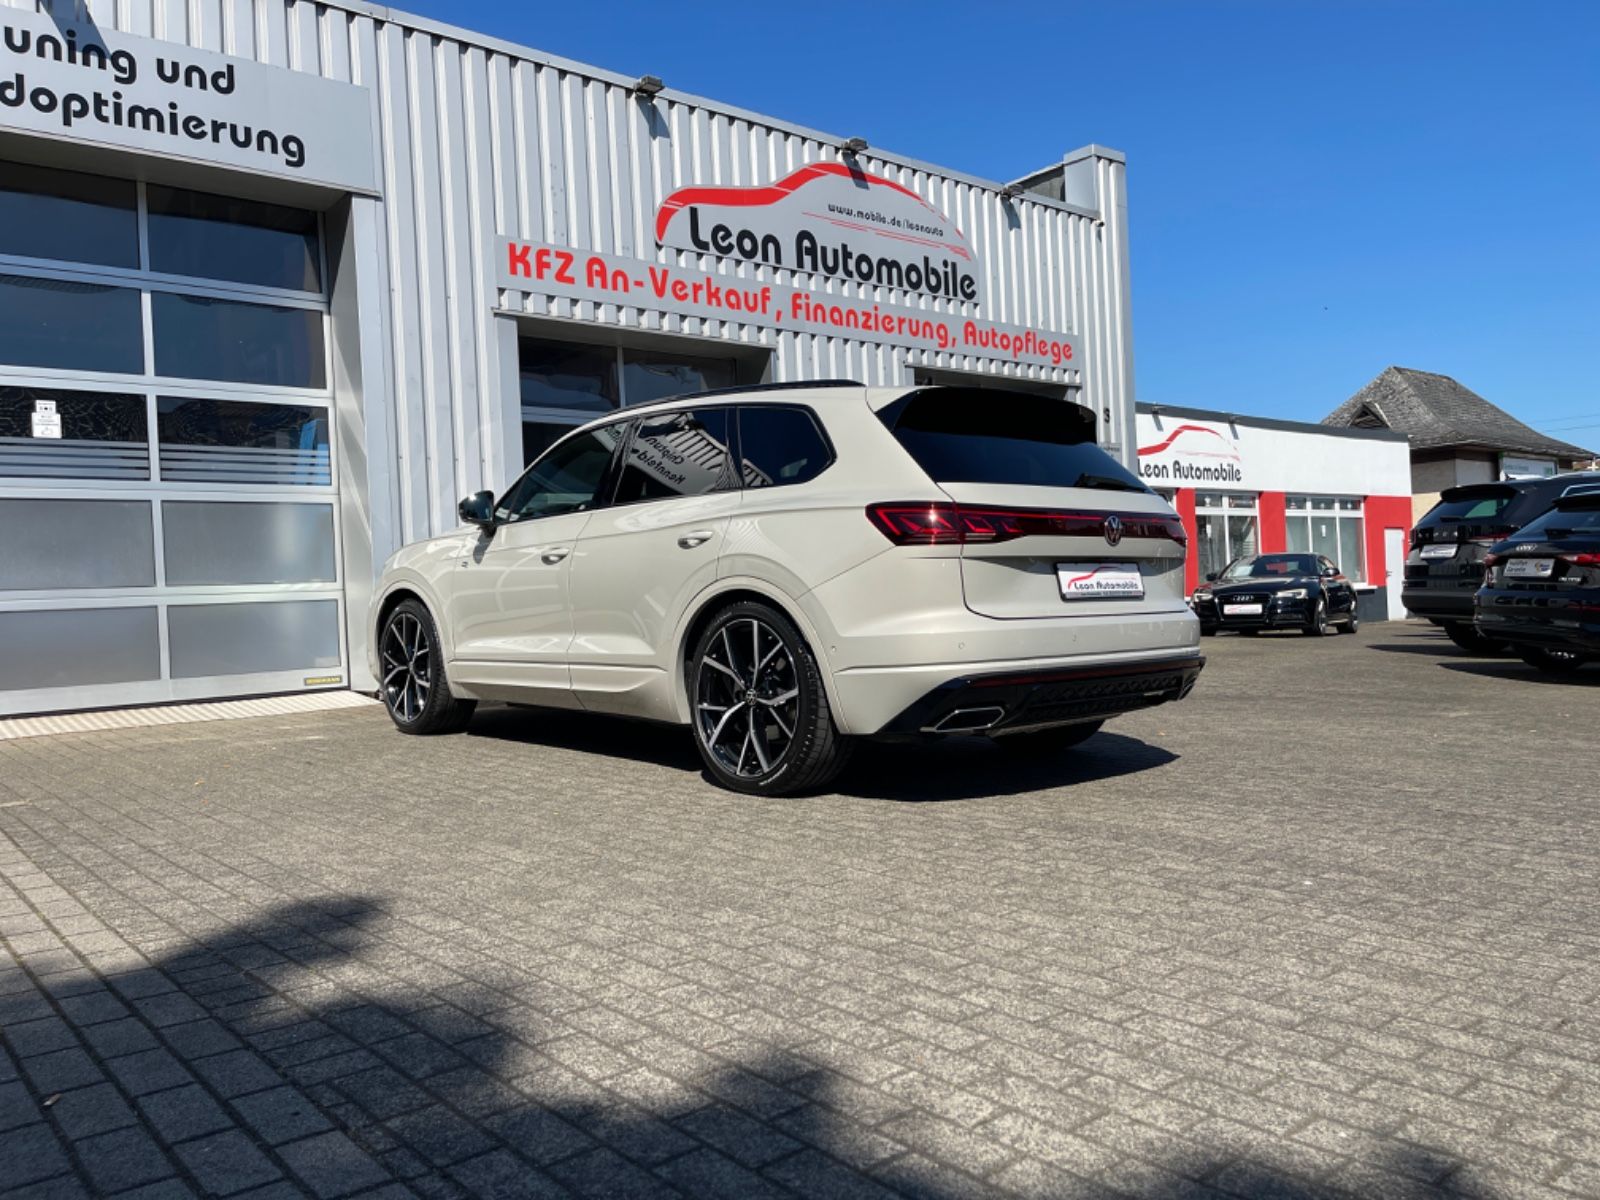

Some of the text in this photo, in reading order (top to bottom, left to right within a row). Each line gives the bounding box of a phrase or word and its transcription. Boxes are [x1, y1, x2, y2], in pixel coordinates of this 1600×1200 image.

[156, 58, 235, 95] und
[0, 73, 305, 168] doptimierung
[828, 203, 944, 237] www.mobile.de/leonauto
[689, 206, 977, 300] Leon Automobile
[507, 242, 576, 285] KFZ
[791, 293, 958, 348] Finanzierung,
[963, 321, 1073, 365] Autopflege
[1137, 458, 1242, 482] Leon Automobile
[1074, 580, 1139, 590] Leon Automobile
